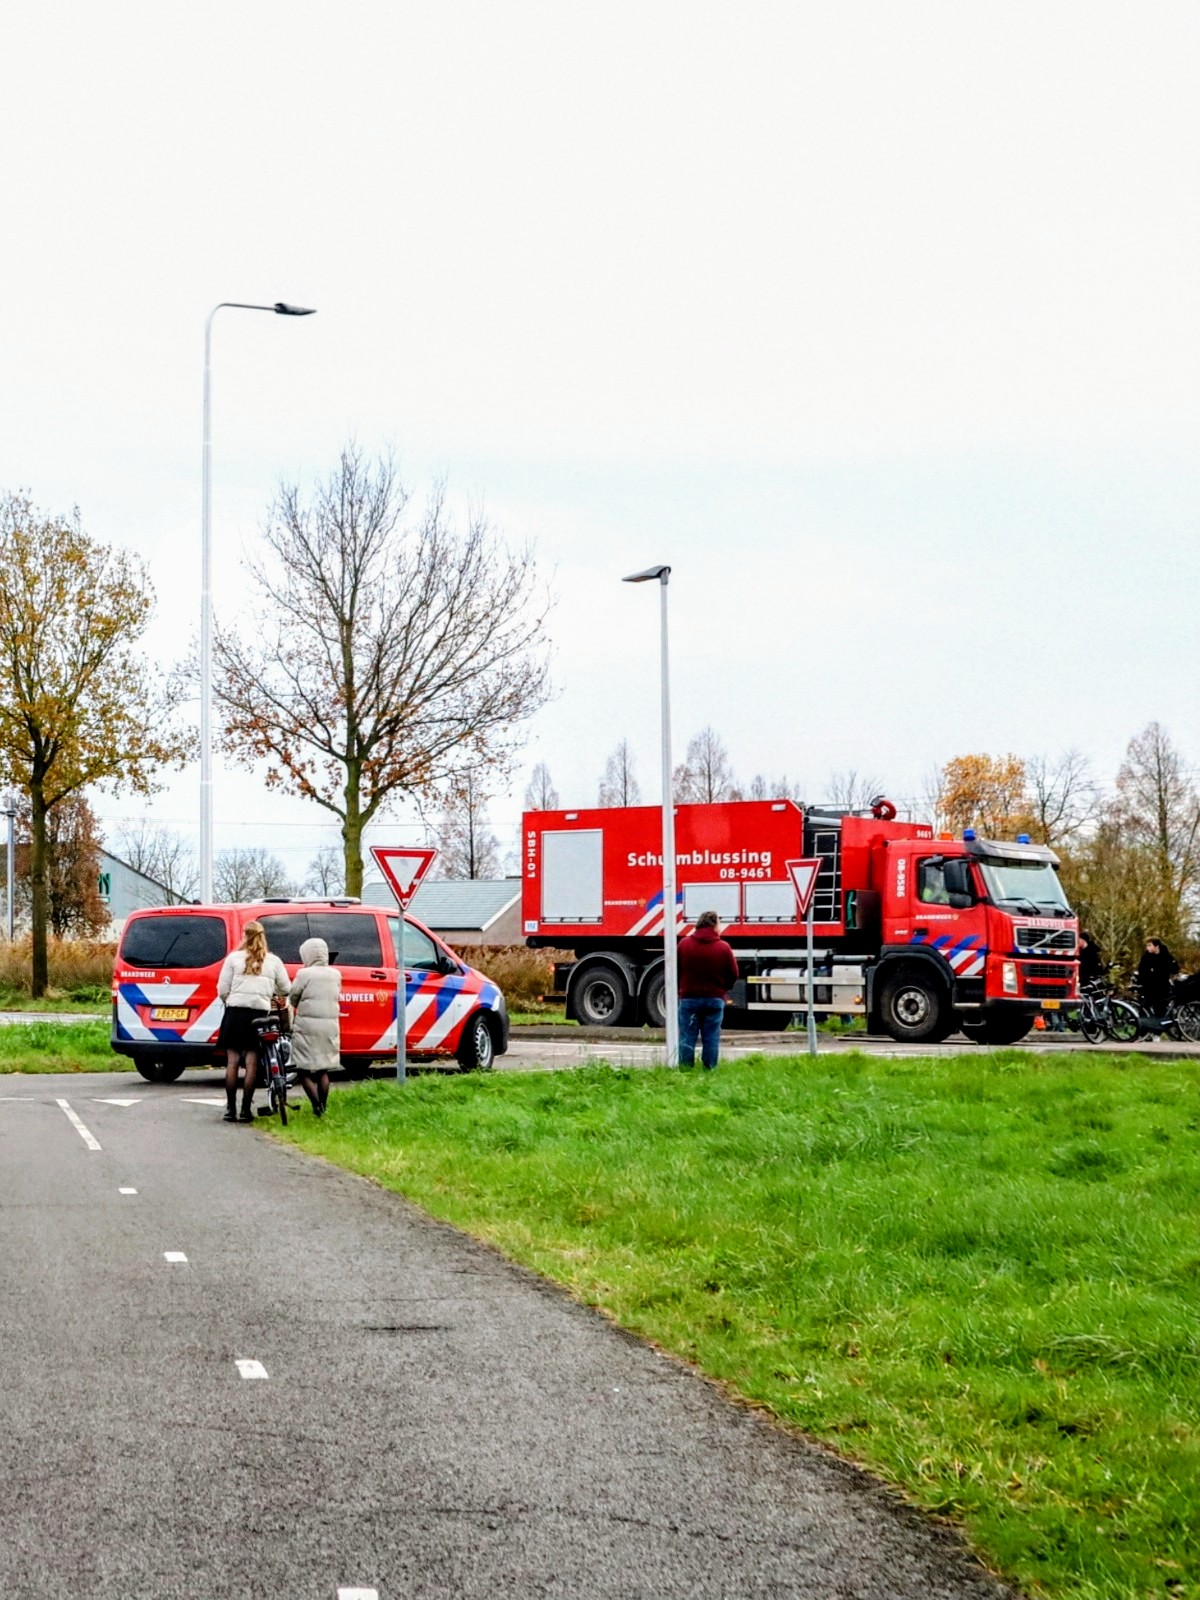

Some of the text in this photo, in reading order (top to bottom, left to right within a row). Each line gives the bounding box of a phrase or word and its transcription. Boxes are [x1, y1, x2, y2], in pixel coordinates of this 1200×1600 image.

[527, 831, 536, 878] SBH-01
[627, 849, 772, 867] Schumblussing
[720, 867, 772, 878] 08-9461
[896, 859, 906, 898] 08-9586
[340, 993, 375, 1003] NDWEER
